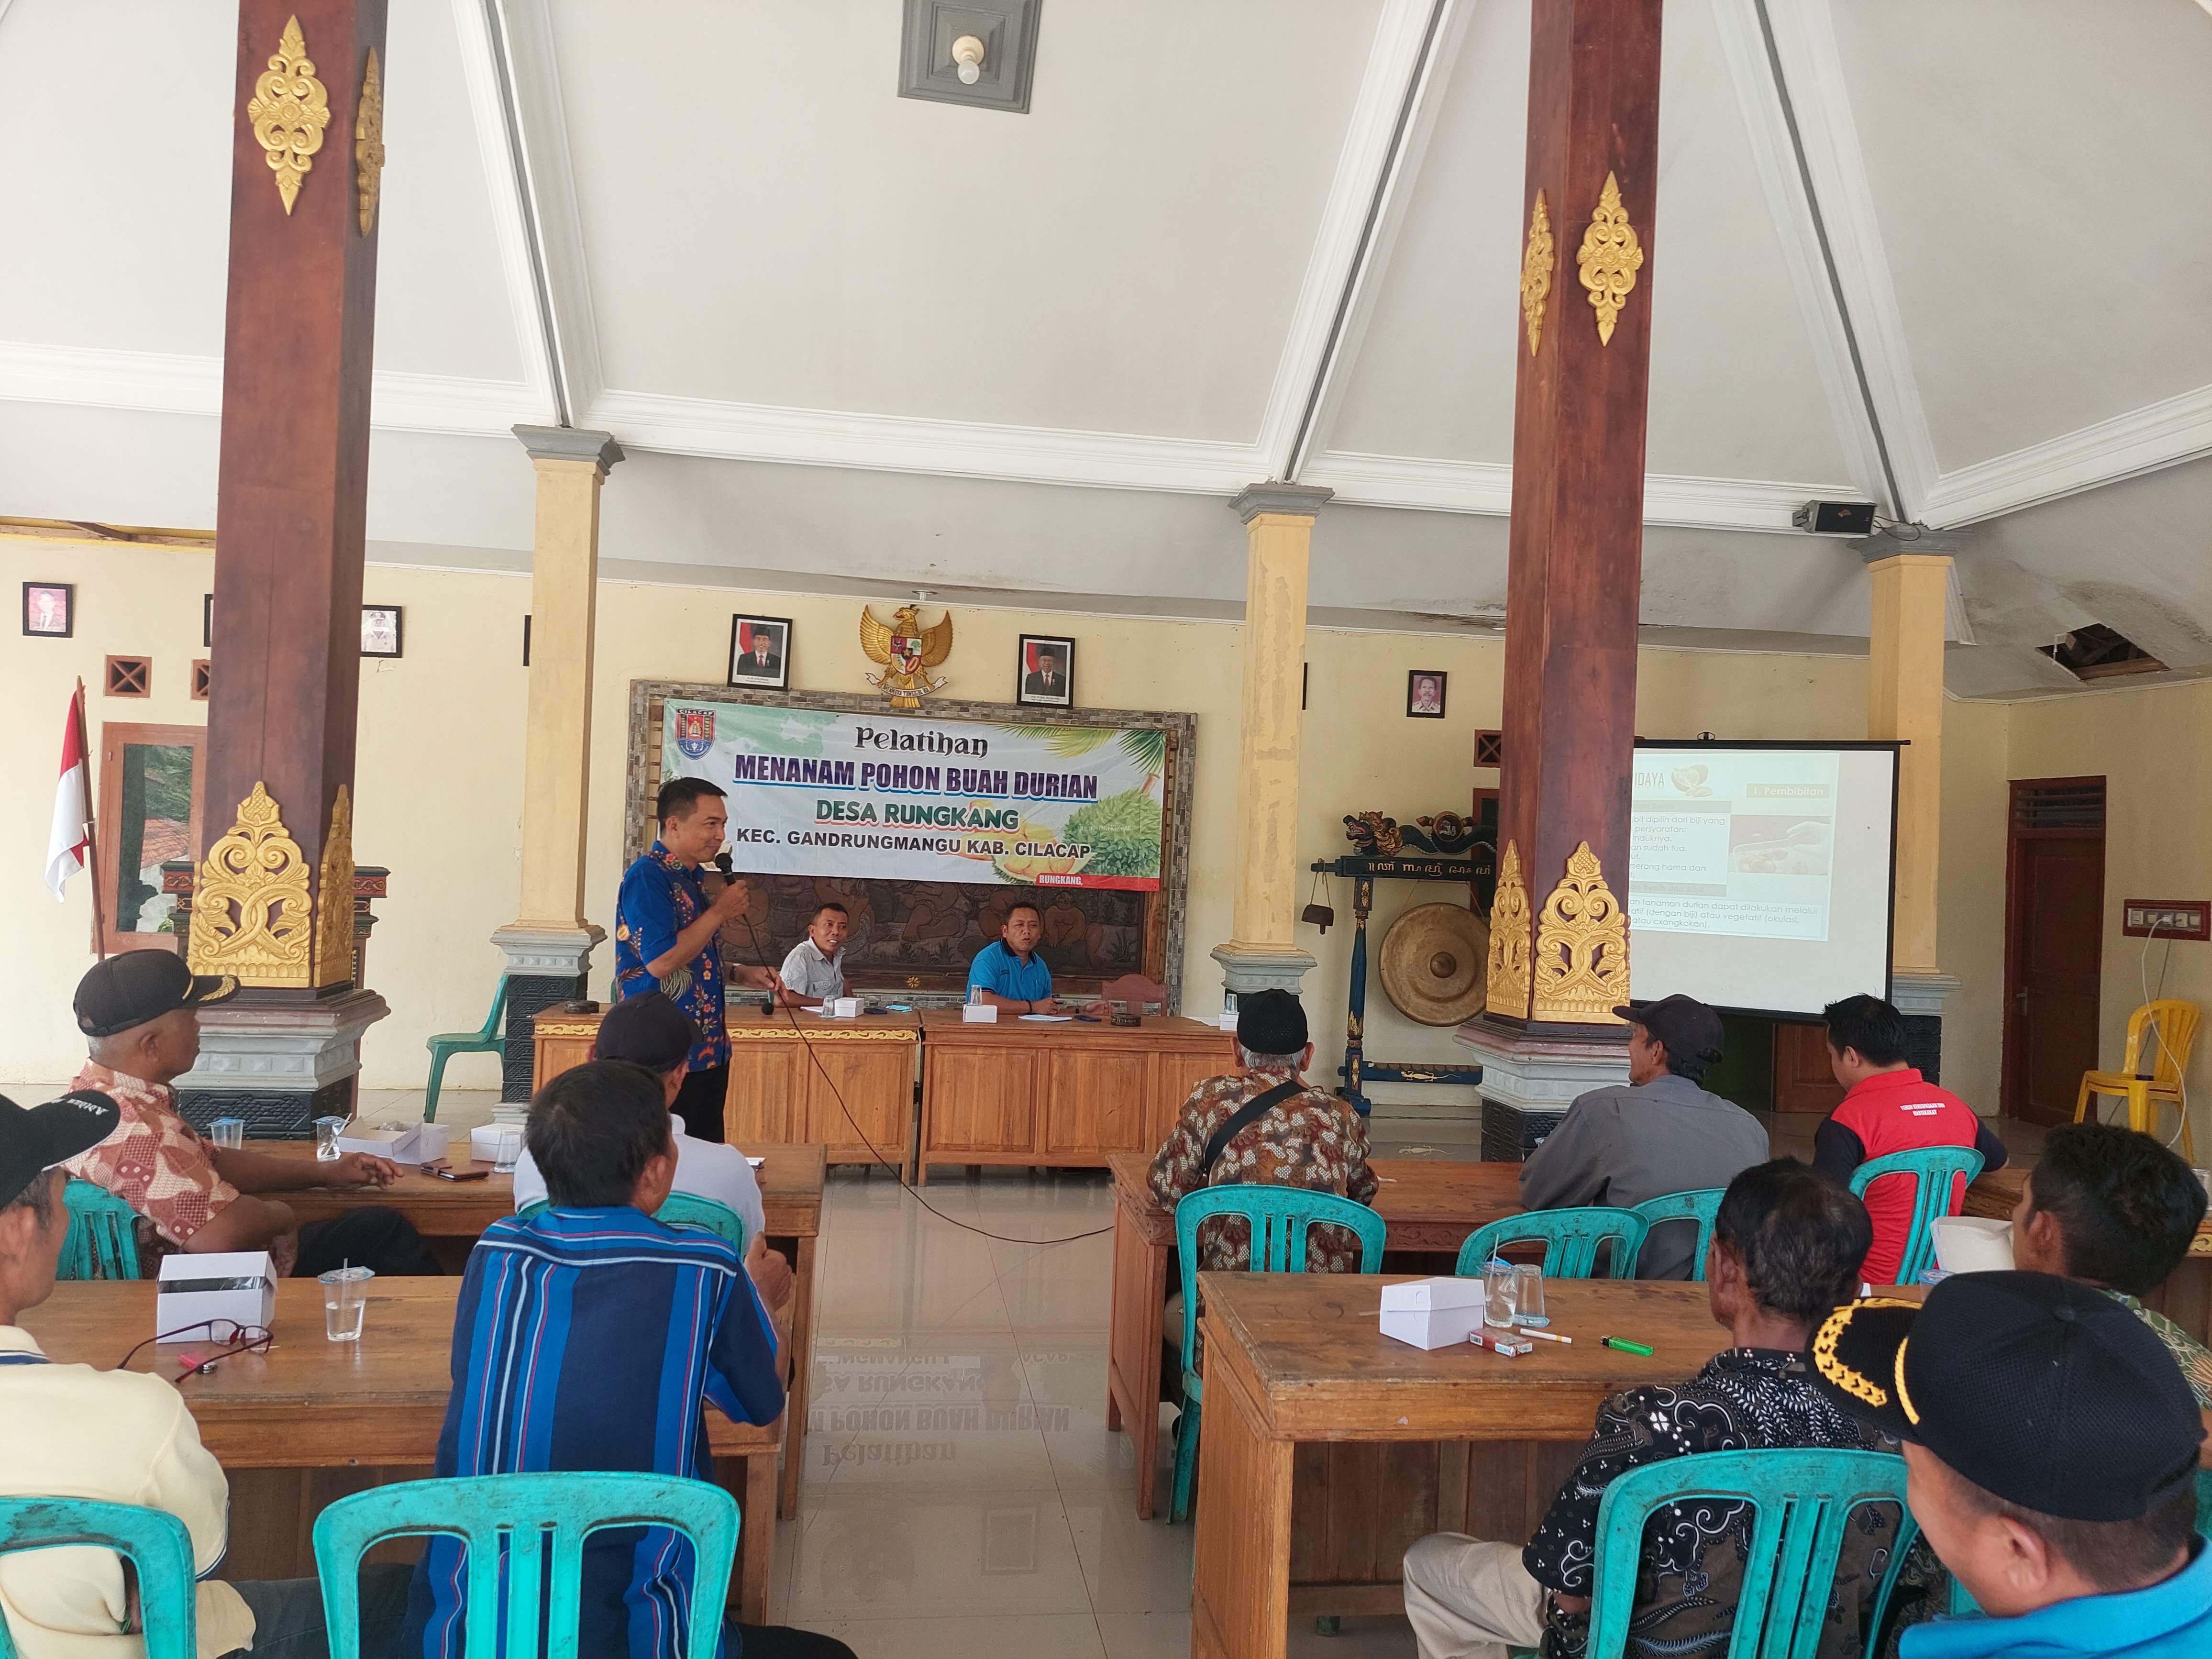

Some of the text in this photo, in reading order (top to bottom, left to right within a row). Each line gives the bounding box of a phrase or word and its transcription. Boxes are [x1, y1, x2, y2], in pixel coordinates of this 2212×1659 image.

[855, 727, 988, 758] Pelatihan
[735, 754, 1097, 799] MENANAM POHON BUAH DURIAN
[1635, 773, 1665, 786] IDAYA
[816, 799, 1019, 830] DESA RUNGKANG
[1646, 815, 1669, 824] dipilih
[1690, 816, 1701, 825] biji
[737, 828, 1091, 859] KEC. GANDRUNGMANGU KAB. CILACAP
[1039, 875, 1083, 886] RUNGKANG,
[1643, 899, 1680, 907] tanaman
[1712, 902, 1737, 911] dapat
[1741, 904, 1783, 913] dilakukan
[1646, 908, 1681, 918] (dengan
[1684, 910, 1697, 919] biji)
[1723, 914, 1762, 922] vegetatif
